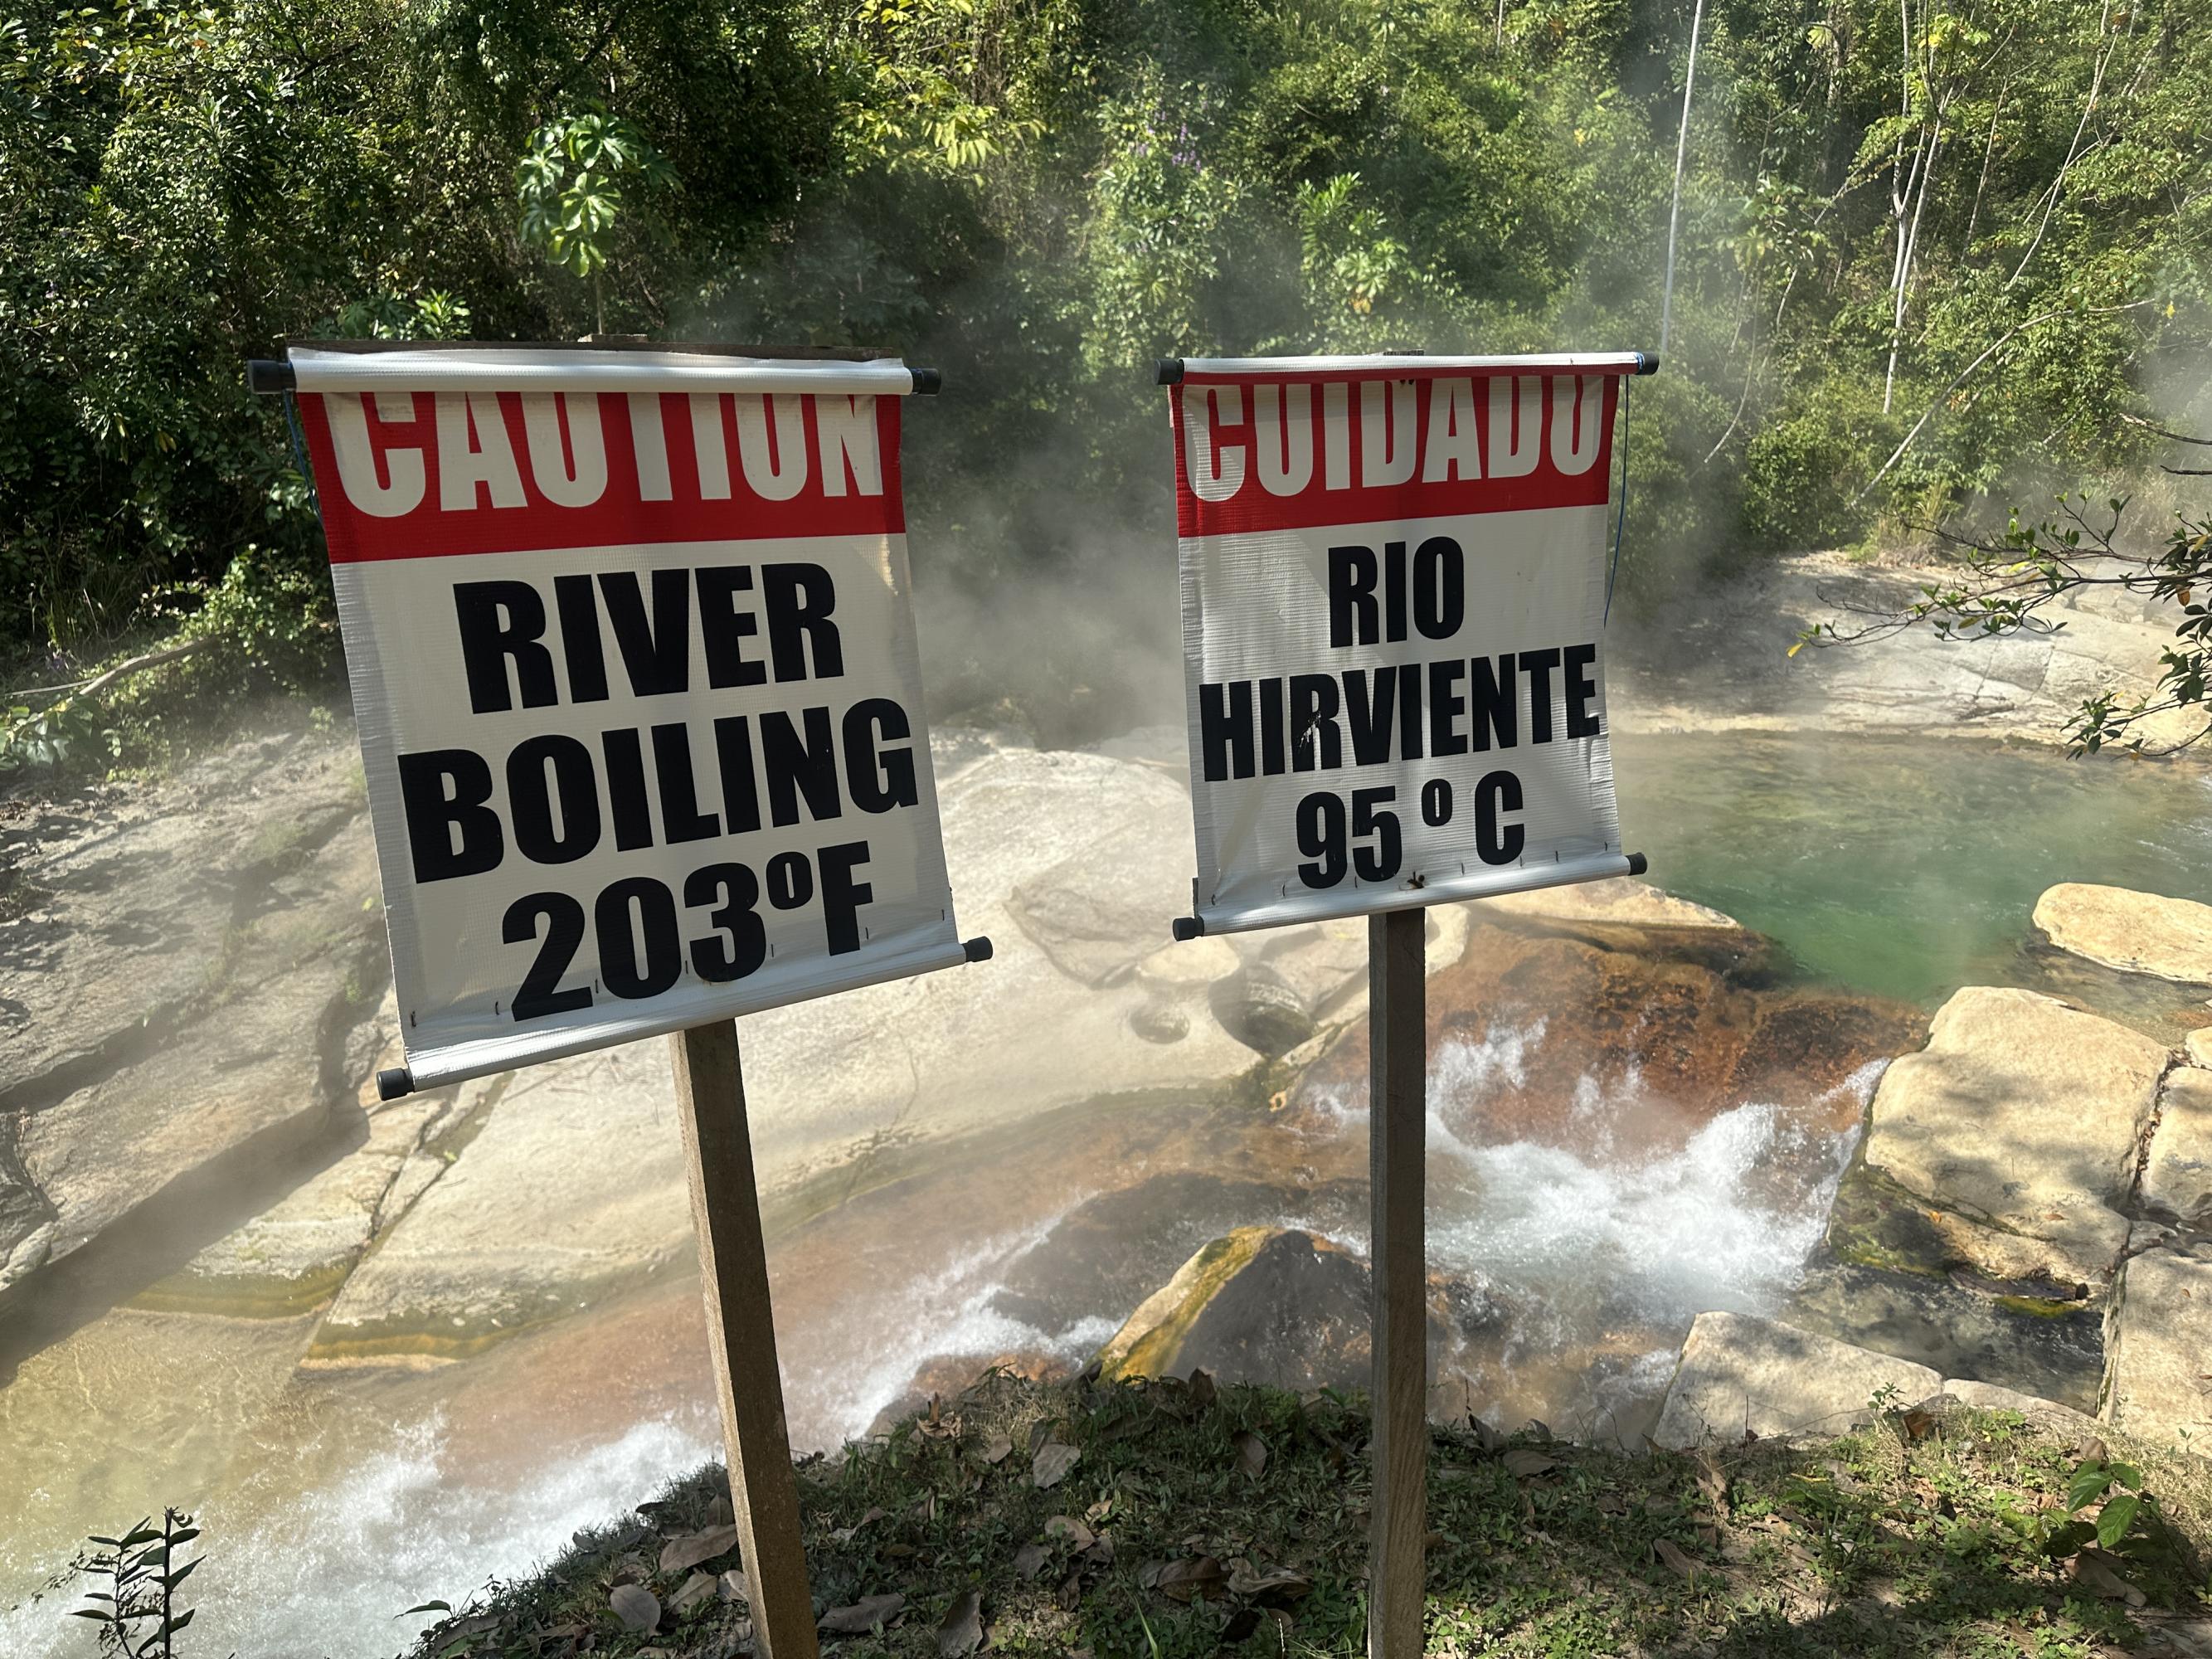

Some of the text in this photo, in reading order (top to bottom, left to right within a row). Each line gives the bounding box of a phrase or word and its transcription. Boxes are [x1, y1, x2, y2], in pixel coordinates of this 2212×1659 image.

[323, 392, 884, 518] CAUTION
[1184, 375, 1605, 502] CUIDADO
[453, 562, 845, 714] RIVER
[1328, 536, 1465, 649] RIO
[1198, 643, 1600, 782] HIRVIENTE
[397, 698, 919, 884] BOILING
